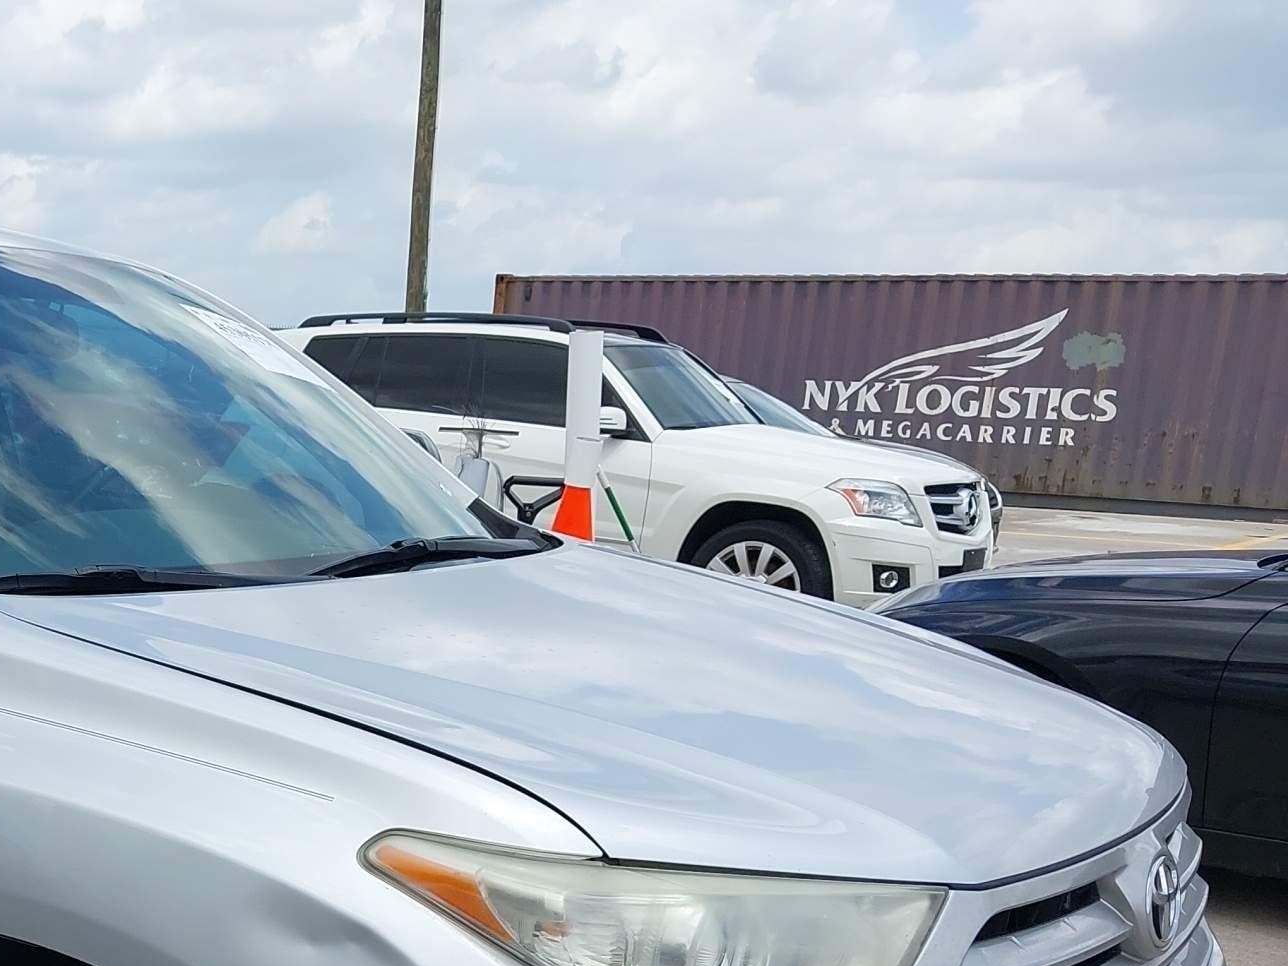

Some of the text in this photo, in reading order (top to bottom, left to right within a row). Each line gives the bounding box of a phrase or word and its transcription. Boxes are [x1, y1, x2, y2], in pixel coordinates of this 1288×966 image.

[802, 379, 1118, 422] NYK LOGISTICS
[827, 418, 1076, 447] & MEGACARRIER
